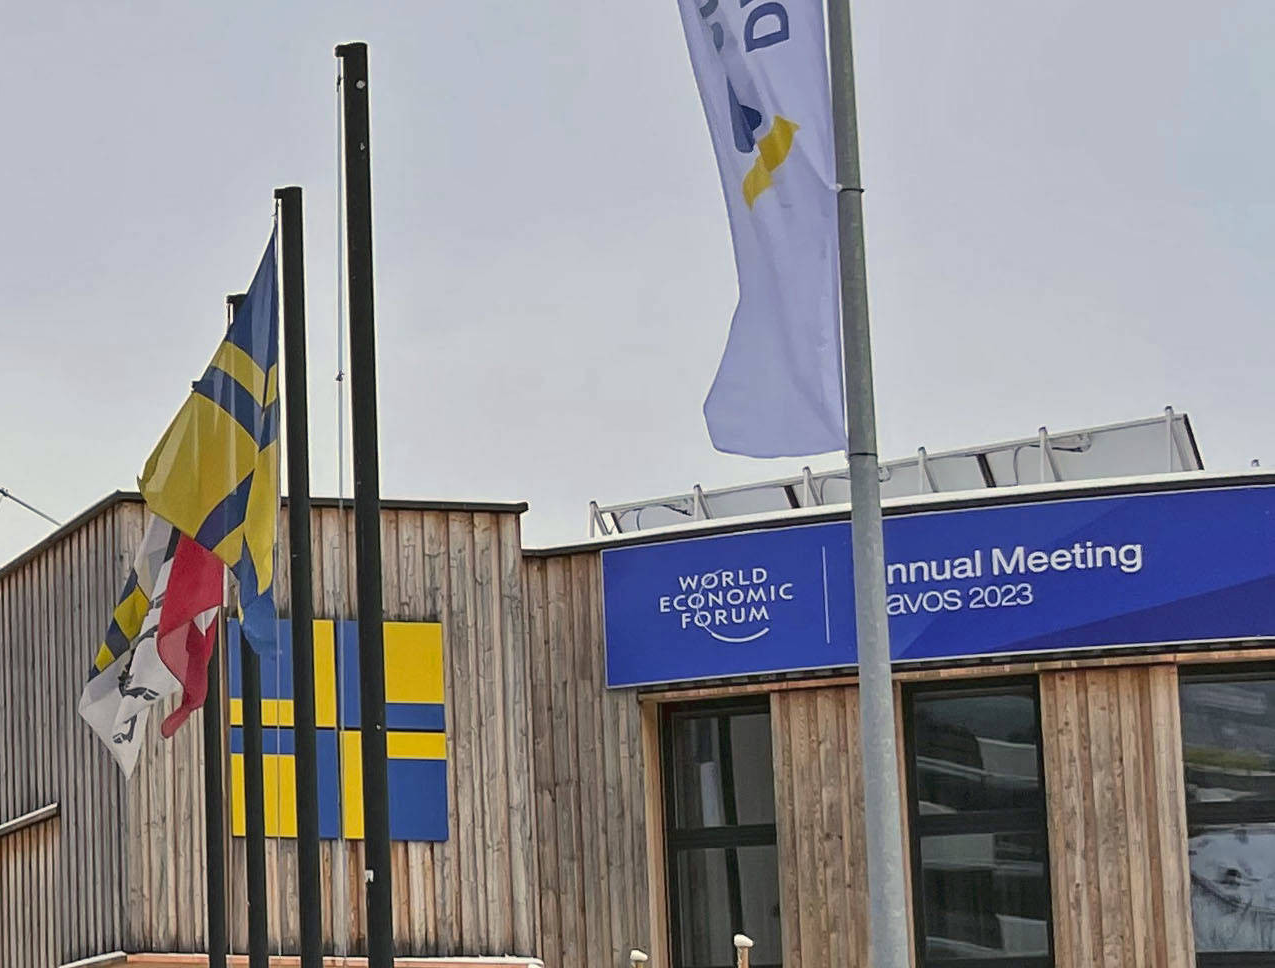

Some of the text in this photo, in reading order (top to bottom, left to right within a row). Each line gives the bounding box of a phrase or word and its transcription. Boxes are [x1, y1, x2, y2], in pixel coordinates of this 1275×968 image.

[886, 541, 1143, 585] nnual Meeting
[678, 567, 767, 592] WORLD
[659, 583, 794, 613] ECONOMIC
[885, 582, 1034, 616] avos 2023
[681, 605, 770, 629] FORUM
